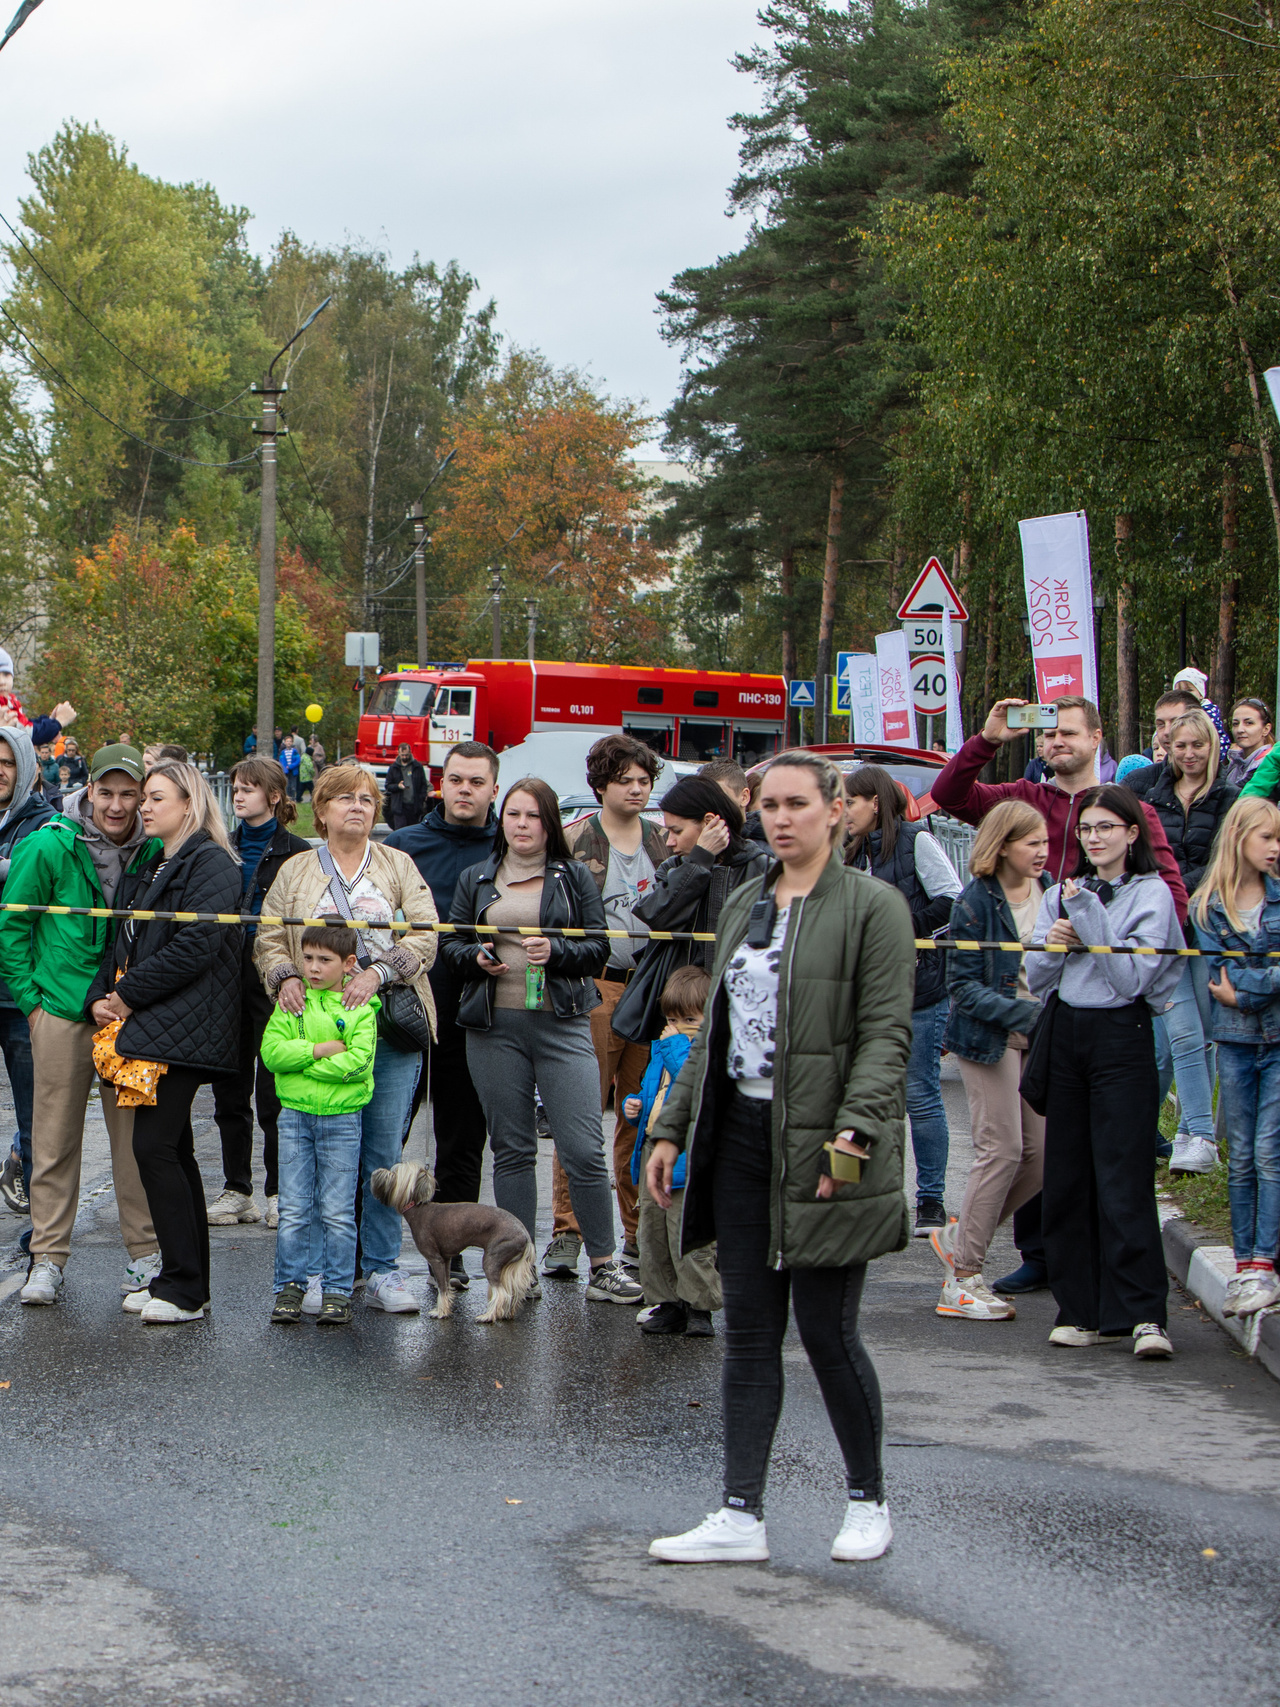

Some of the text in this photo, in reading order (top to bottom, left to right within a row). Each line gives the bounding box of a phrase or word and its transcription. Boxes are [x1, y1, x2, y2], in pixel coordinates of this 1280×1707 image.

[914, 628, 943, 646] 50
[913, 673, 947, 697] 40
[738, 692, 781, 705] ПНС-130
[441, 728, 460, 741] 131
